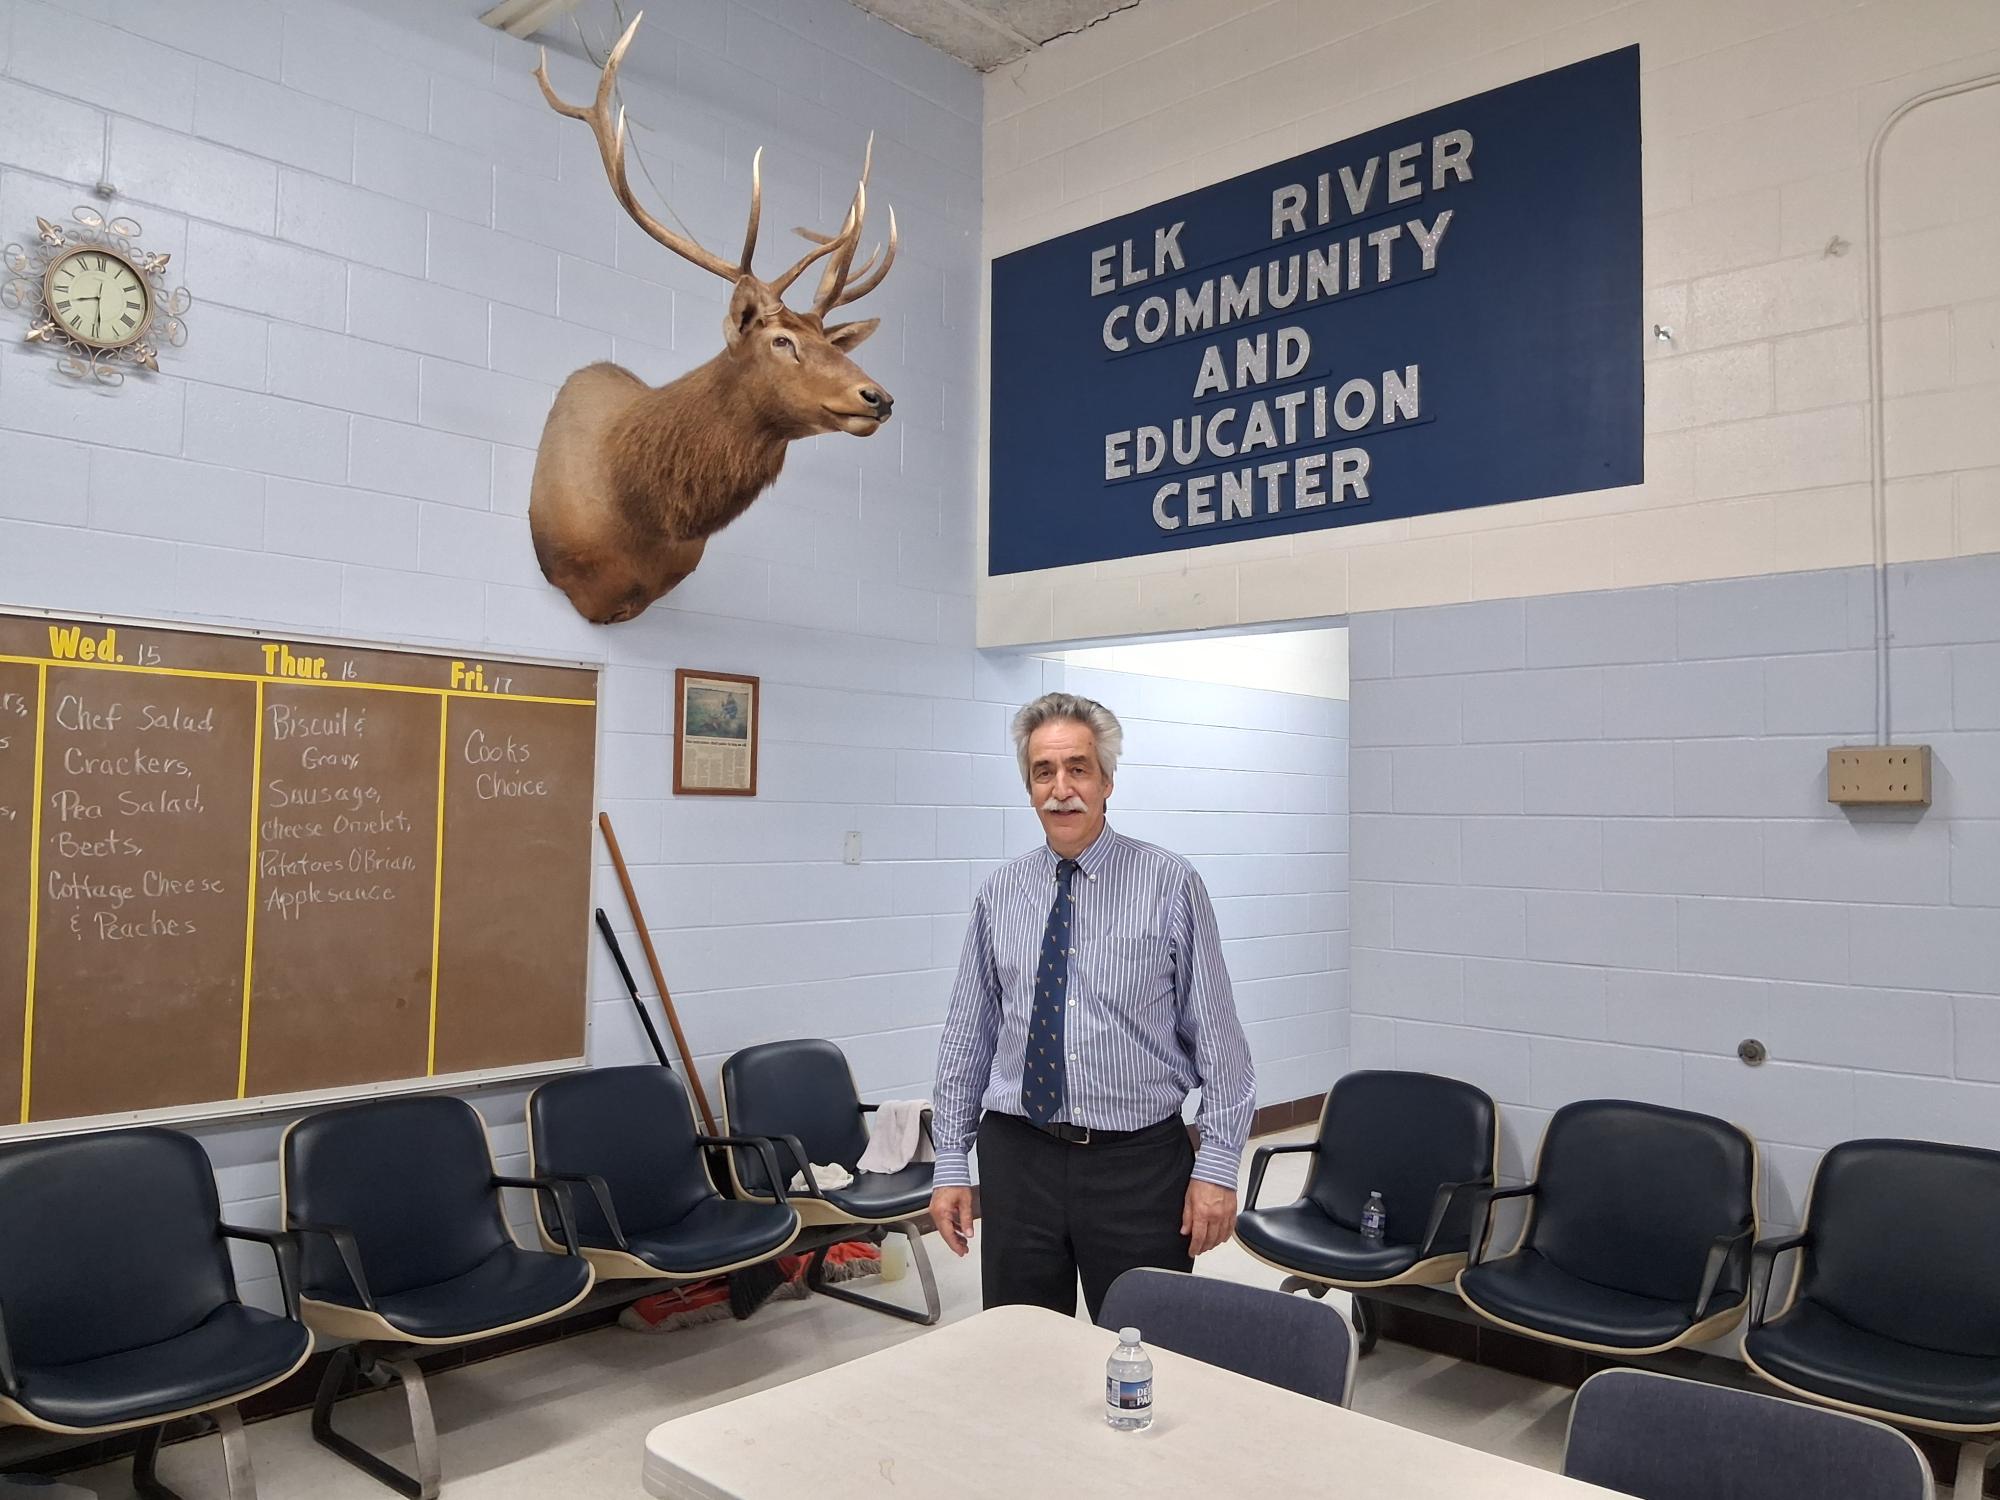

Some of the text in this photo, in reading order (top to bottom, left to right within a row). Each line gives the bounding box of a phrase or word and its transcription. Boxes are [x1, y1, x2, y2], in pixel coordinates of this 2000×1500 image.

[1090, 128, 1475, 298] ELK RIVER
[1102, 209, 1454, 353] COMMUNITY
[1192, 326, 1312, 398] AND
[1104, 364, 1420, 481] EDUCATION
[1151, 447, 1371, 531] CENTER
[49, 626, 124, 662] Wed.
[137, 643, 162, 666] 15
[261, 643, 329, 680] Thur.
[341, 660, 358, 681] 16
[451, 661, 489, 692] Fri.
[493, 676, 513, 694] 17
[56, 695, 123, 732] Chef
[64, 747, 193, 779] Crackers,
[464, 728, 531, 764] Cooks
[476, 768, 548, 800] Choice
[51, 789, 104, 822] Pea
[50, 828, 143, 858] Beets,
[258, 848, 345, 879] Potatoes
[48, 870, 225, 910] Cottage Cheese
[94, 909, 197, 941] Peaches
